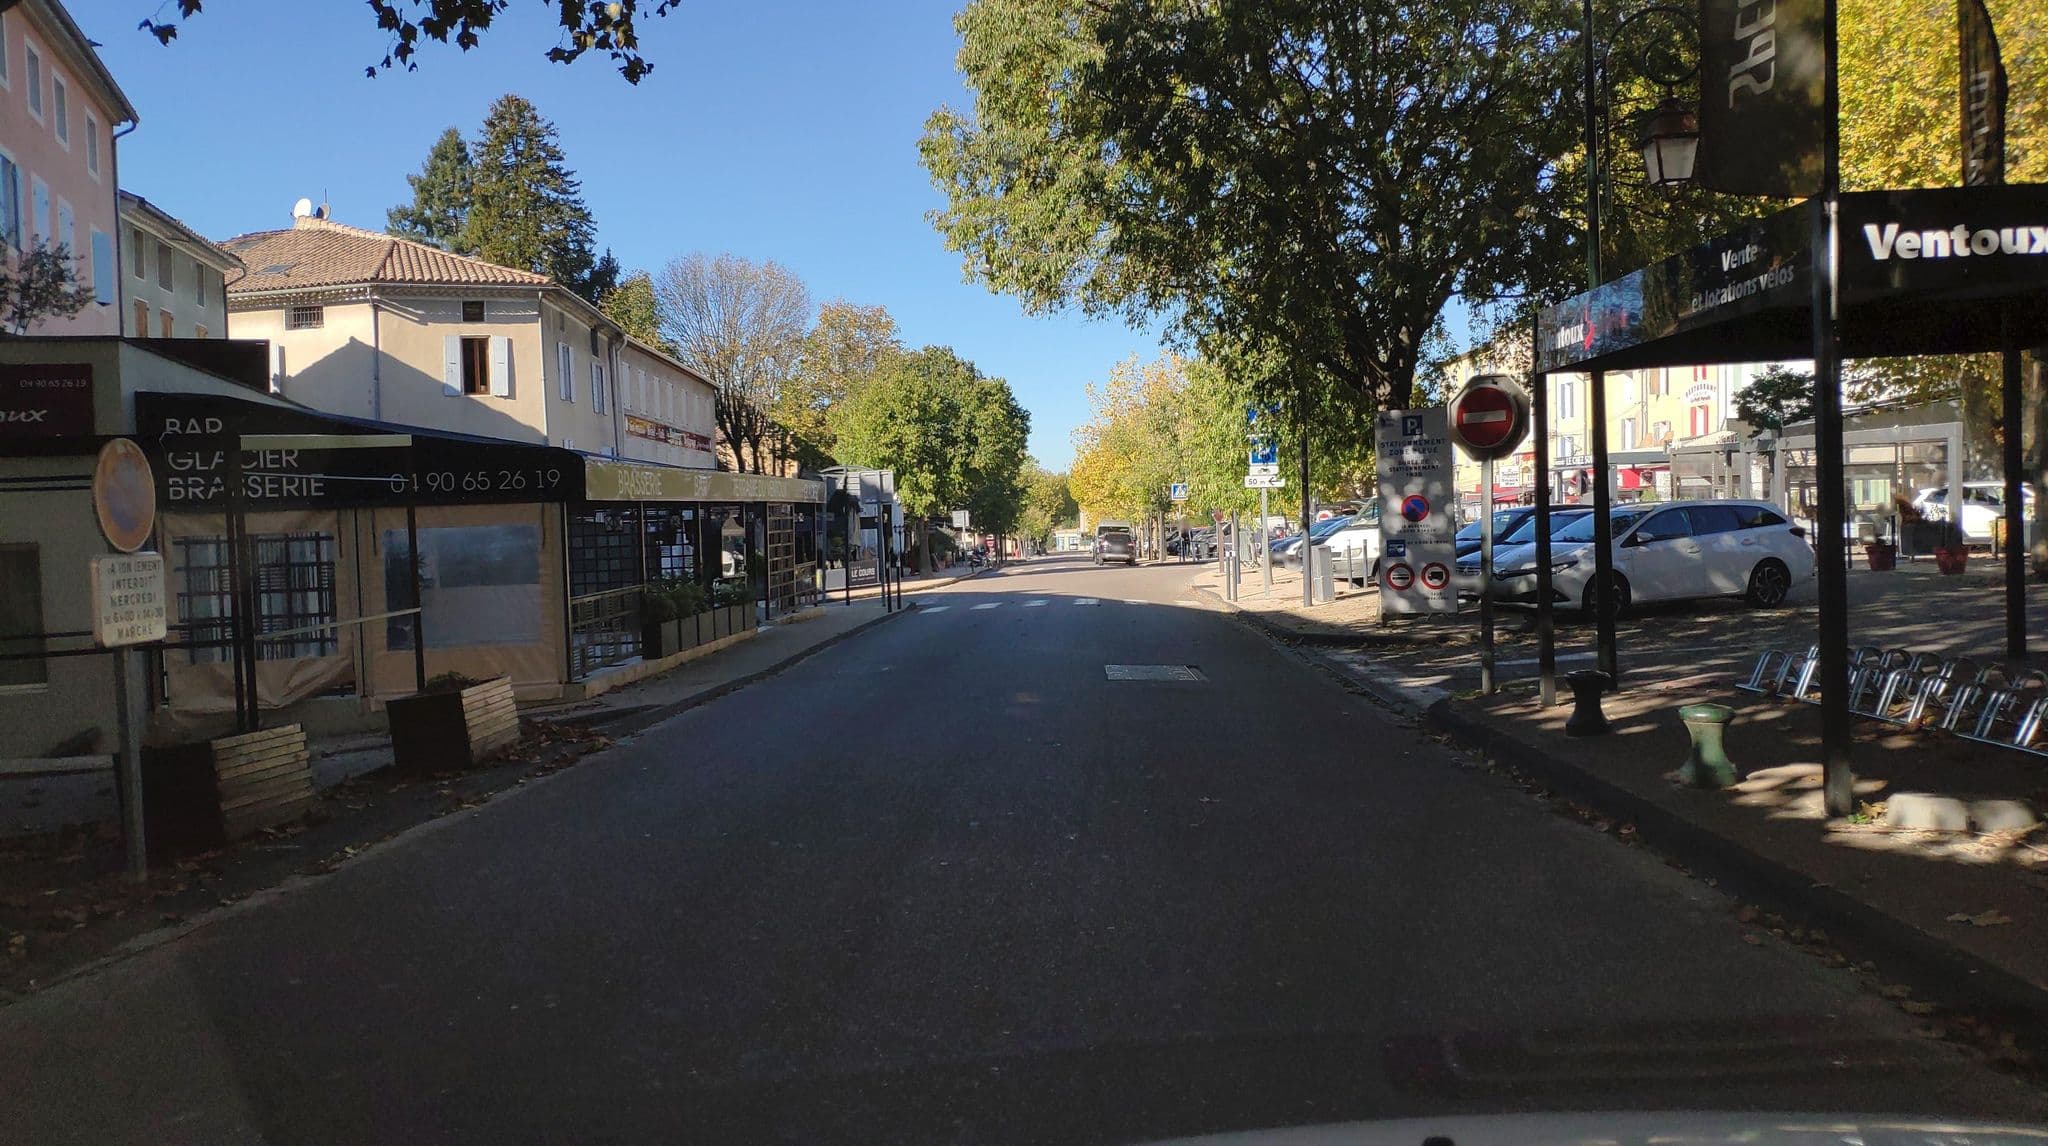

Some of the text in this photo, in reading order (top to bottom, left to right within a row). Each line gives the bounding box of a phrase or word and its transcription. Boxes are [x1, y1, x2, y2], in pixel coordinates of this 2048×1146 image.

[1863, 222, 2048, 260] Ventoux
[1721, 243, 1758, 272] Vente
[1705, 277, 1757, 310] locations
[168, 476, 325, 501] BRASERIE
[426, 471, 455, 492] 90
[462, 471, 490, 491] 65
[499, 470, 526, 490] 26
[535, 468, 561, 489] 19
[618, 469, 662, 498] BRASSERIE
